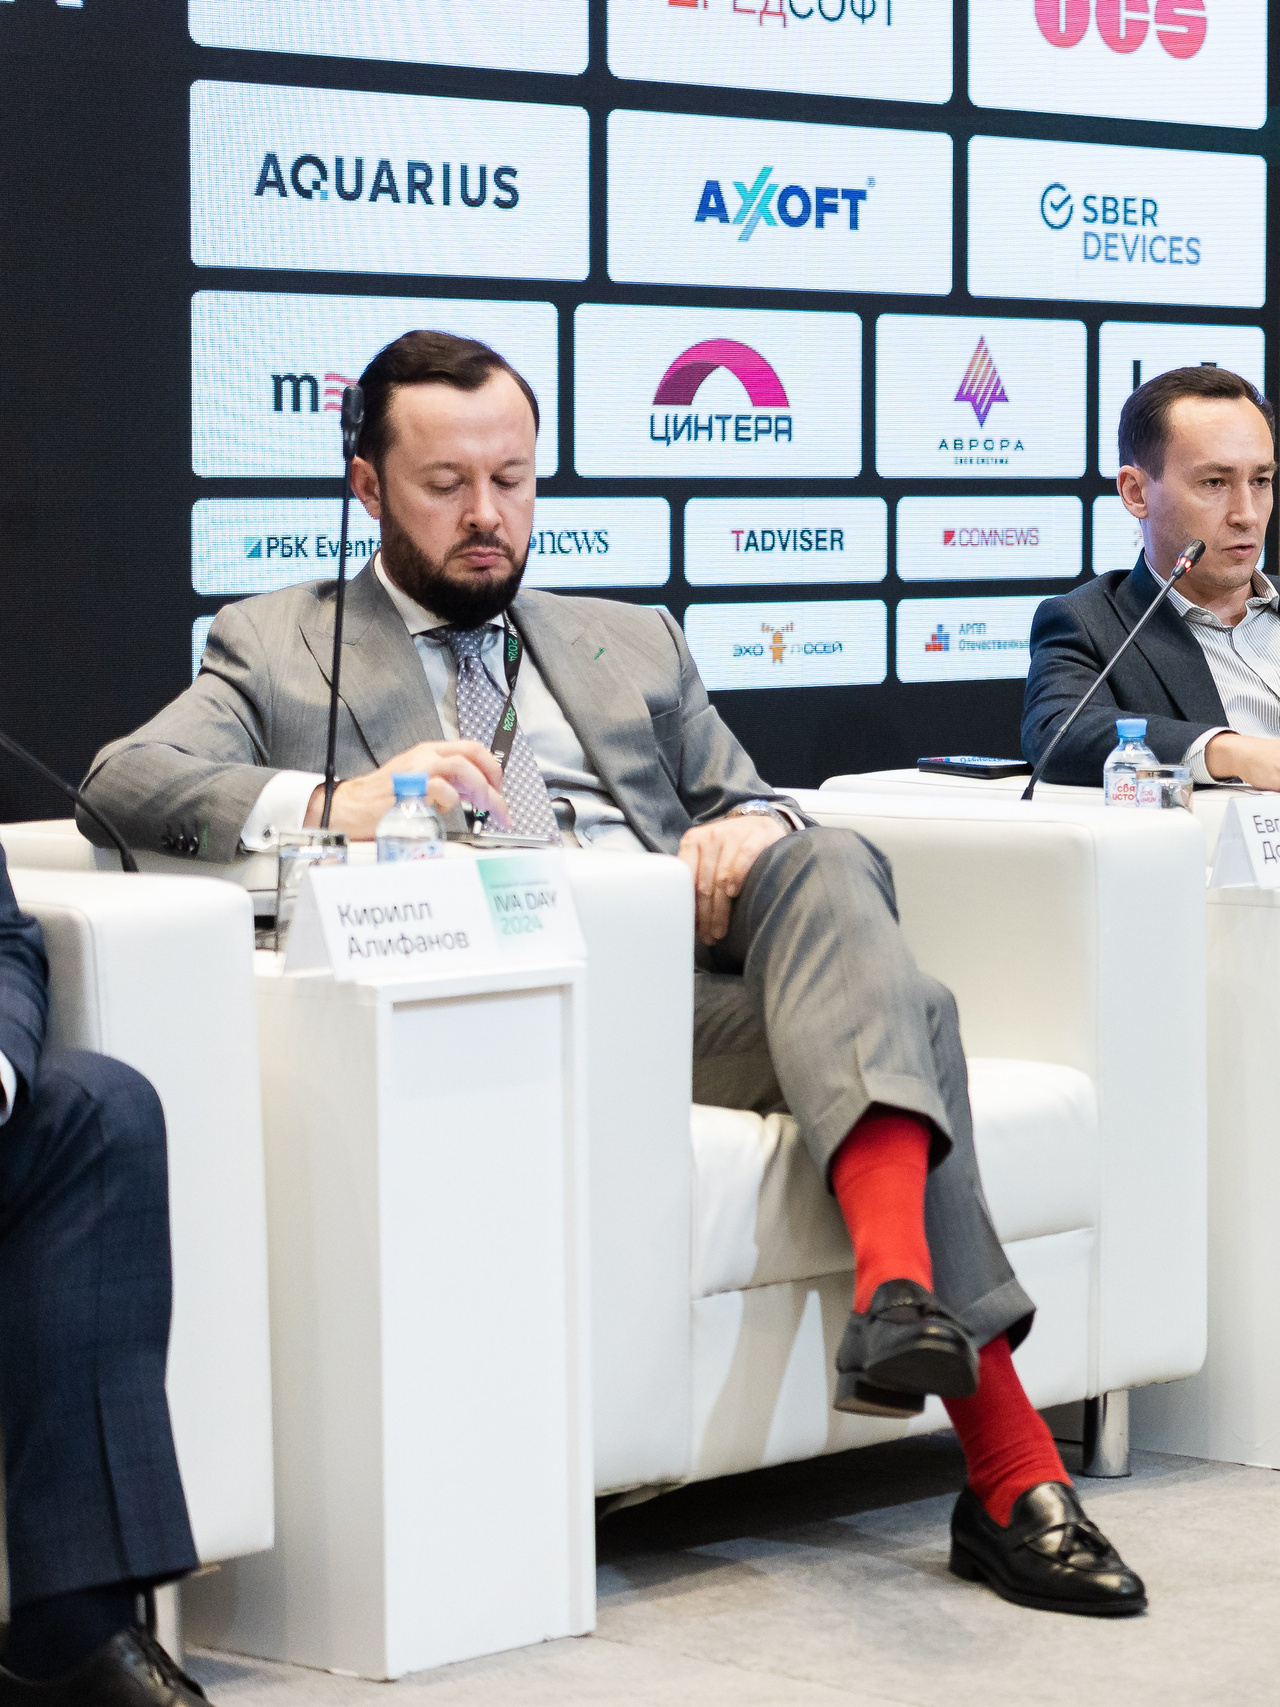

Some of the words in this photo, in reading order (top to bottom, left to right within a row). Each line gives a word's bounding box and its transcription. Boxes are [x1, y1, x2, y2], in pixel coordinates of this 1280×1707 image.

[254, 151, 520, 210] AQUARIUS
[694, 165, 867, 242] AXOFT
[1083, 195, 1158, 227] SBER
[1083, 232, 1201, 265] DEVICES
[650, 413, 792, 446] ЦИНТЕРА
[938, 438, 1024, 451] АВРОРА
[266, 537, 308, 558] РБК
[731, 529, 844, 552] TADVISER
[959, 528, 1039, 546] COMNEWS
[508, 637, 518, 662] 2024
[502, 706, 516, 732] 2024
[524, 891, 558, 911] DAY
[337, 902, 433, 929] Кирилл
[502, 914, 545, 936] 2024
[348, 930, 472, 960] Алифанов
